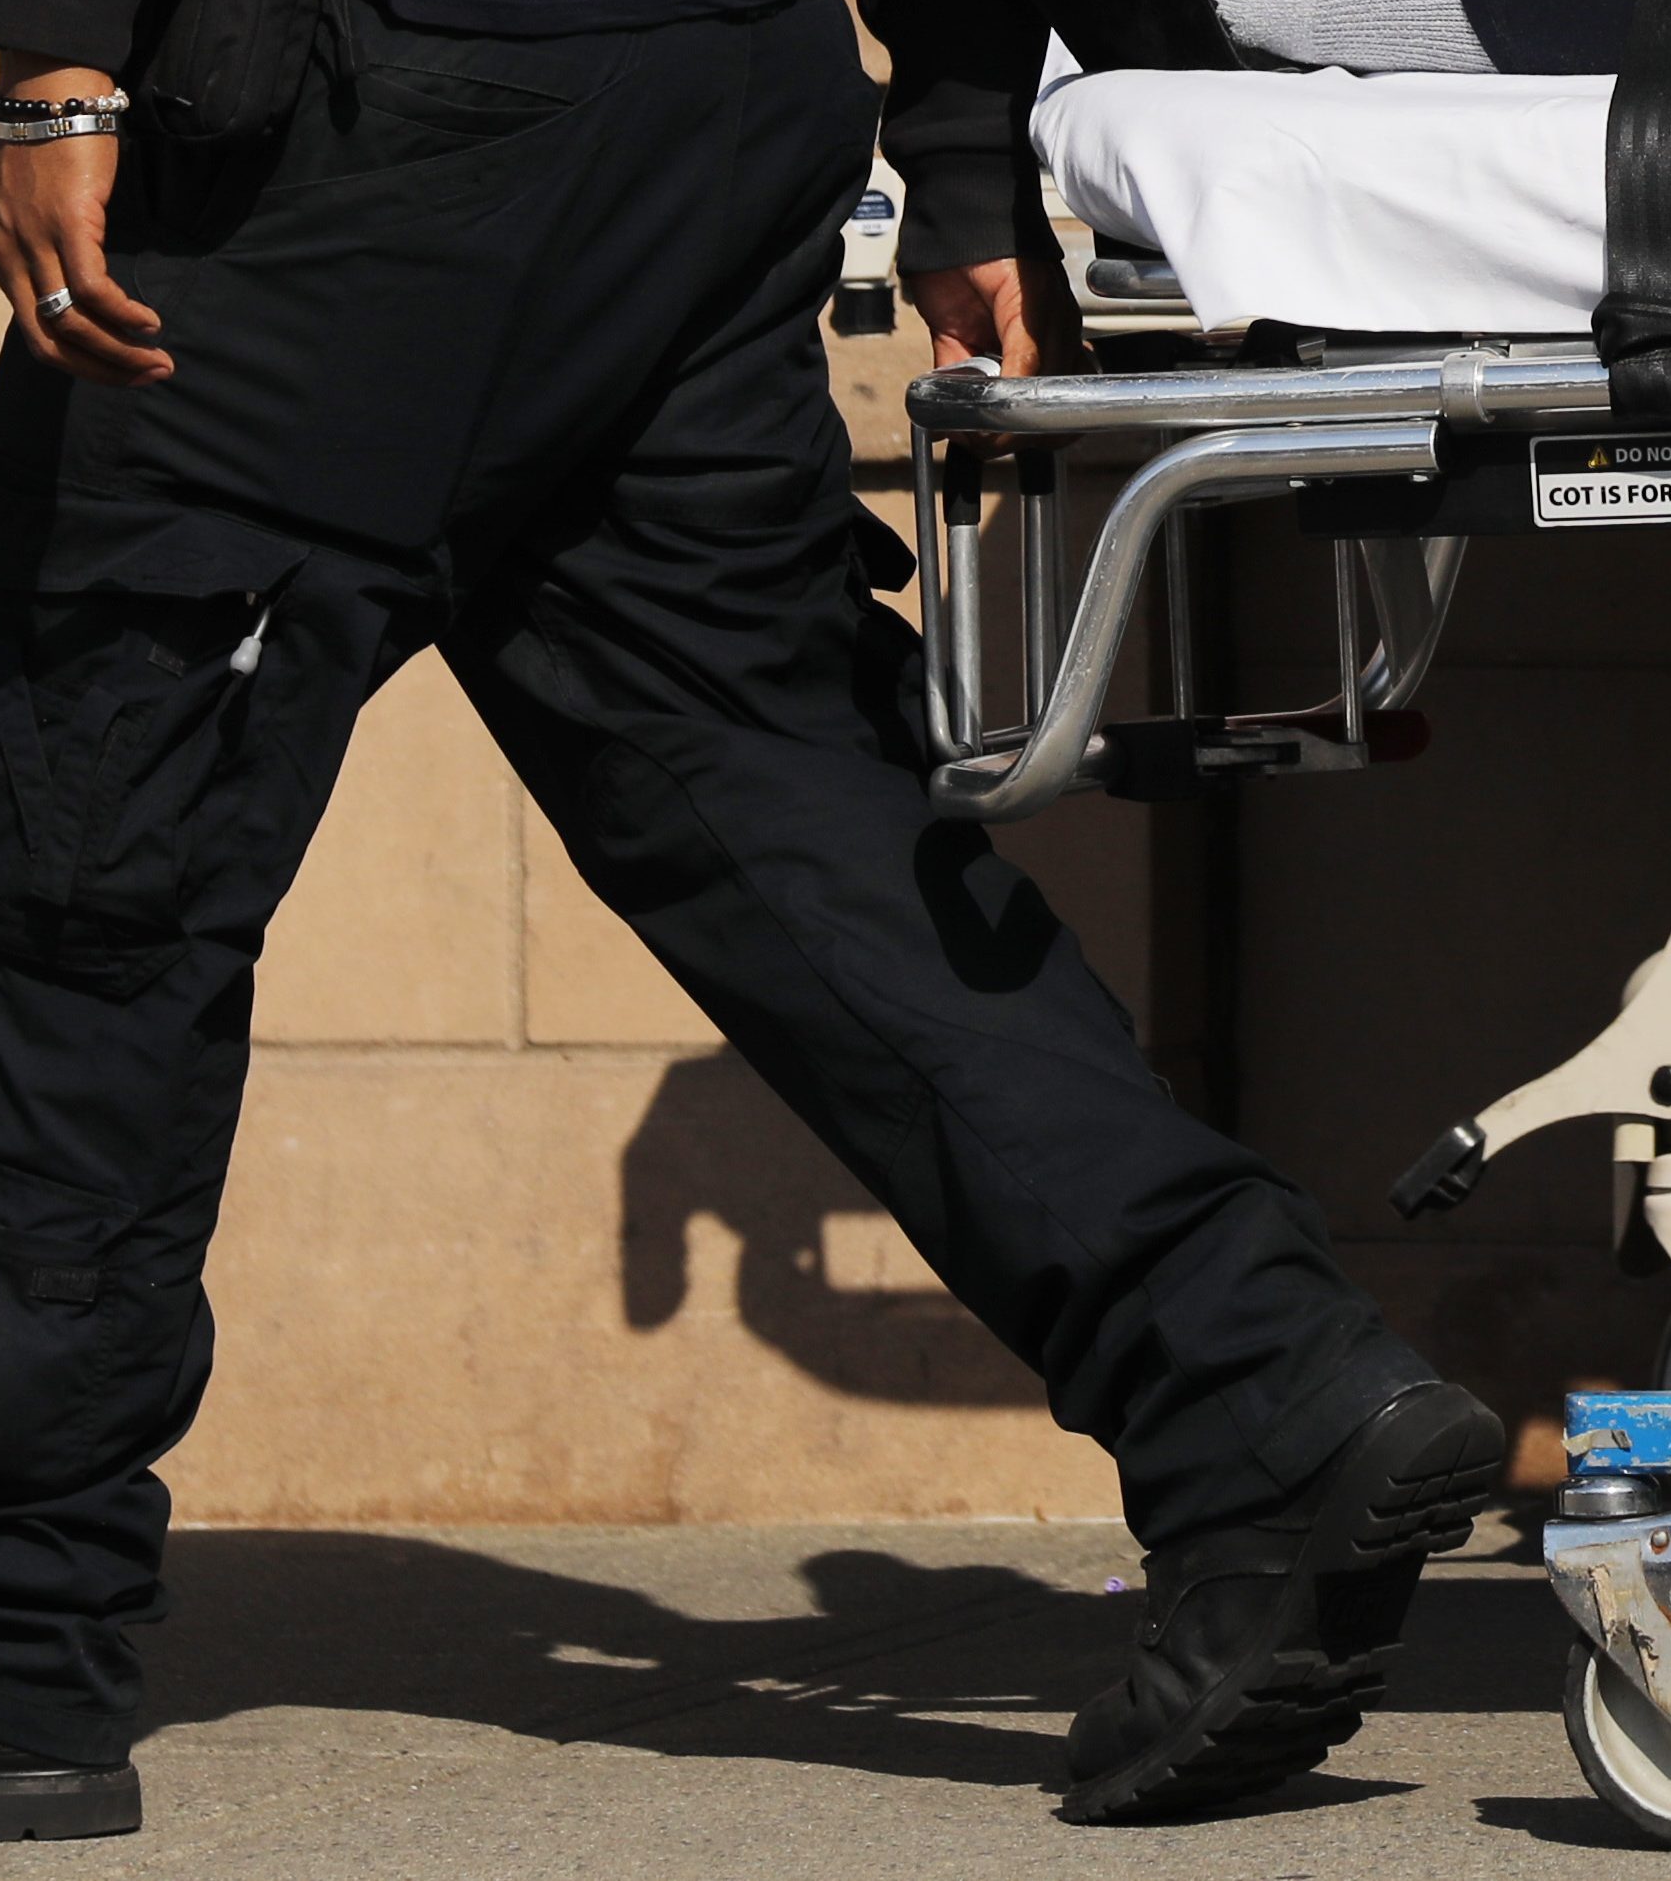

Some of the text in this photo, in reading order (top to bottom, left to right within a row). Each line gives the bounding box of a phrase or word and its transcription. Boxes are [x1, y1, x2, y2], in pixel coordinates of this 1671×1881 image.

[1615, 447, 1643, 464] DO
[1548, 486, 1594, 506] COT
[1600, 485, 1622, 504] IS
